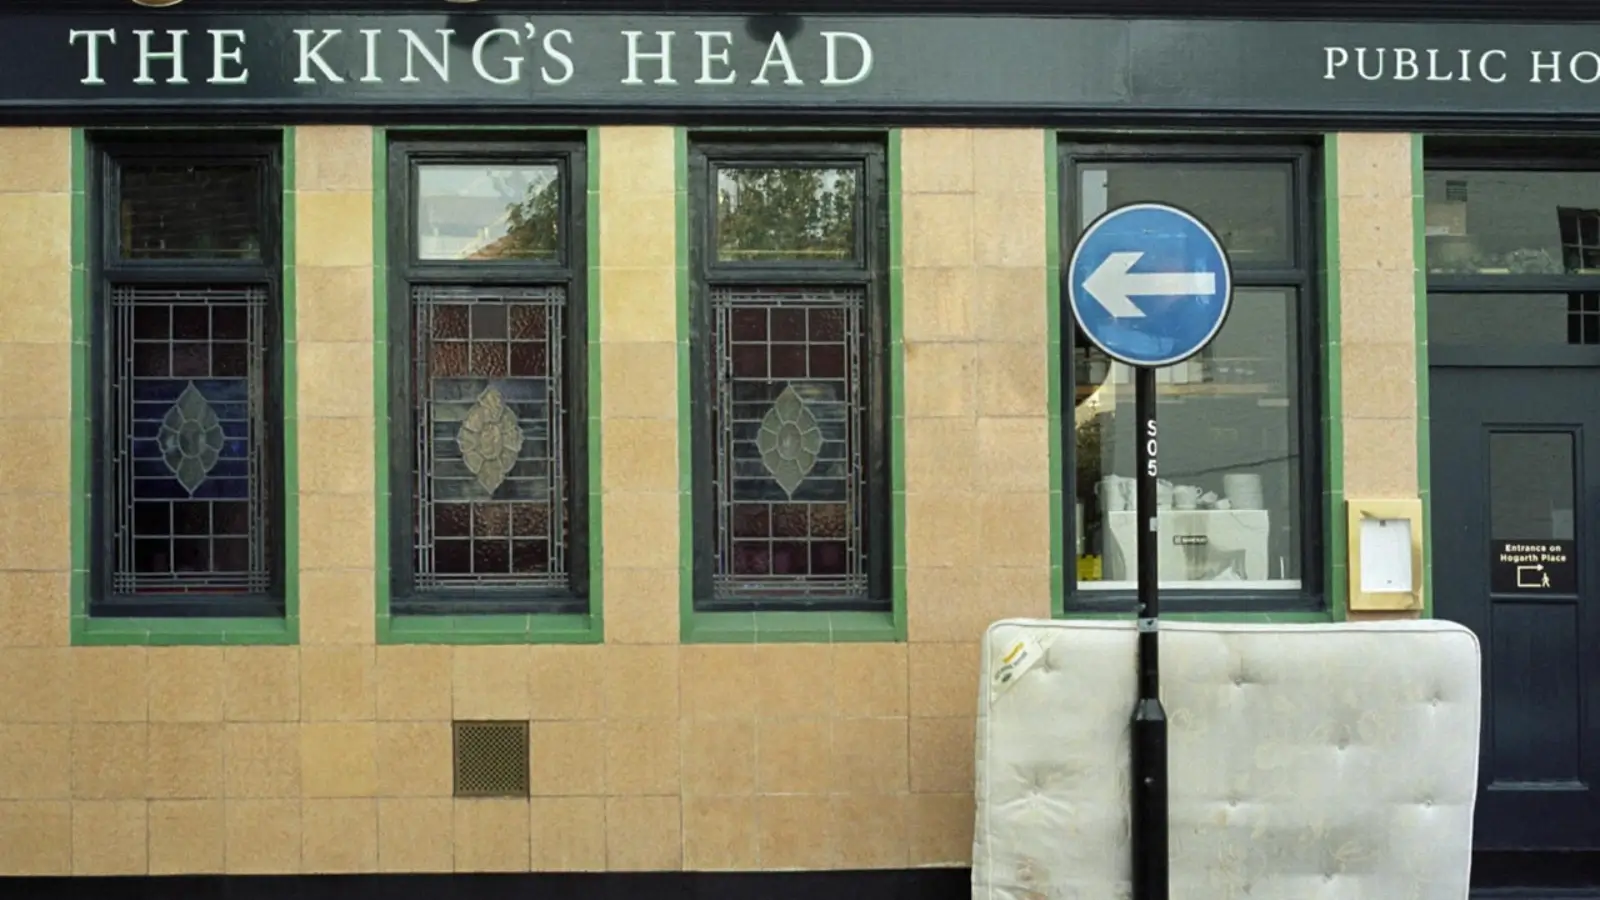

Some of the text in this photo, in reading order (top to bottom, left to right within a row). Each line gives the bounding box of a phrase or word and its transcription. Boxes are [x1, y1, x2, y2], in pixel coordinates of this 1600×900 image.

[69, 22, 875, 87] THE KING'S HEAD
[1323, 46, 1600, 84] PUBLIC HO
[1500, 553, 1567, 564] Hogarth Place
[1504, 543, 1547, 552] Entrance
